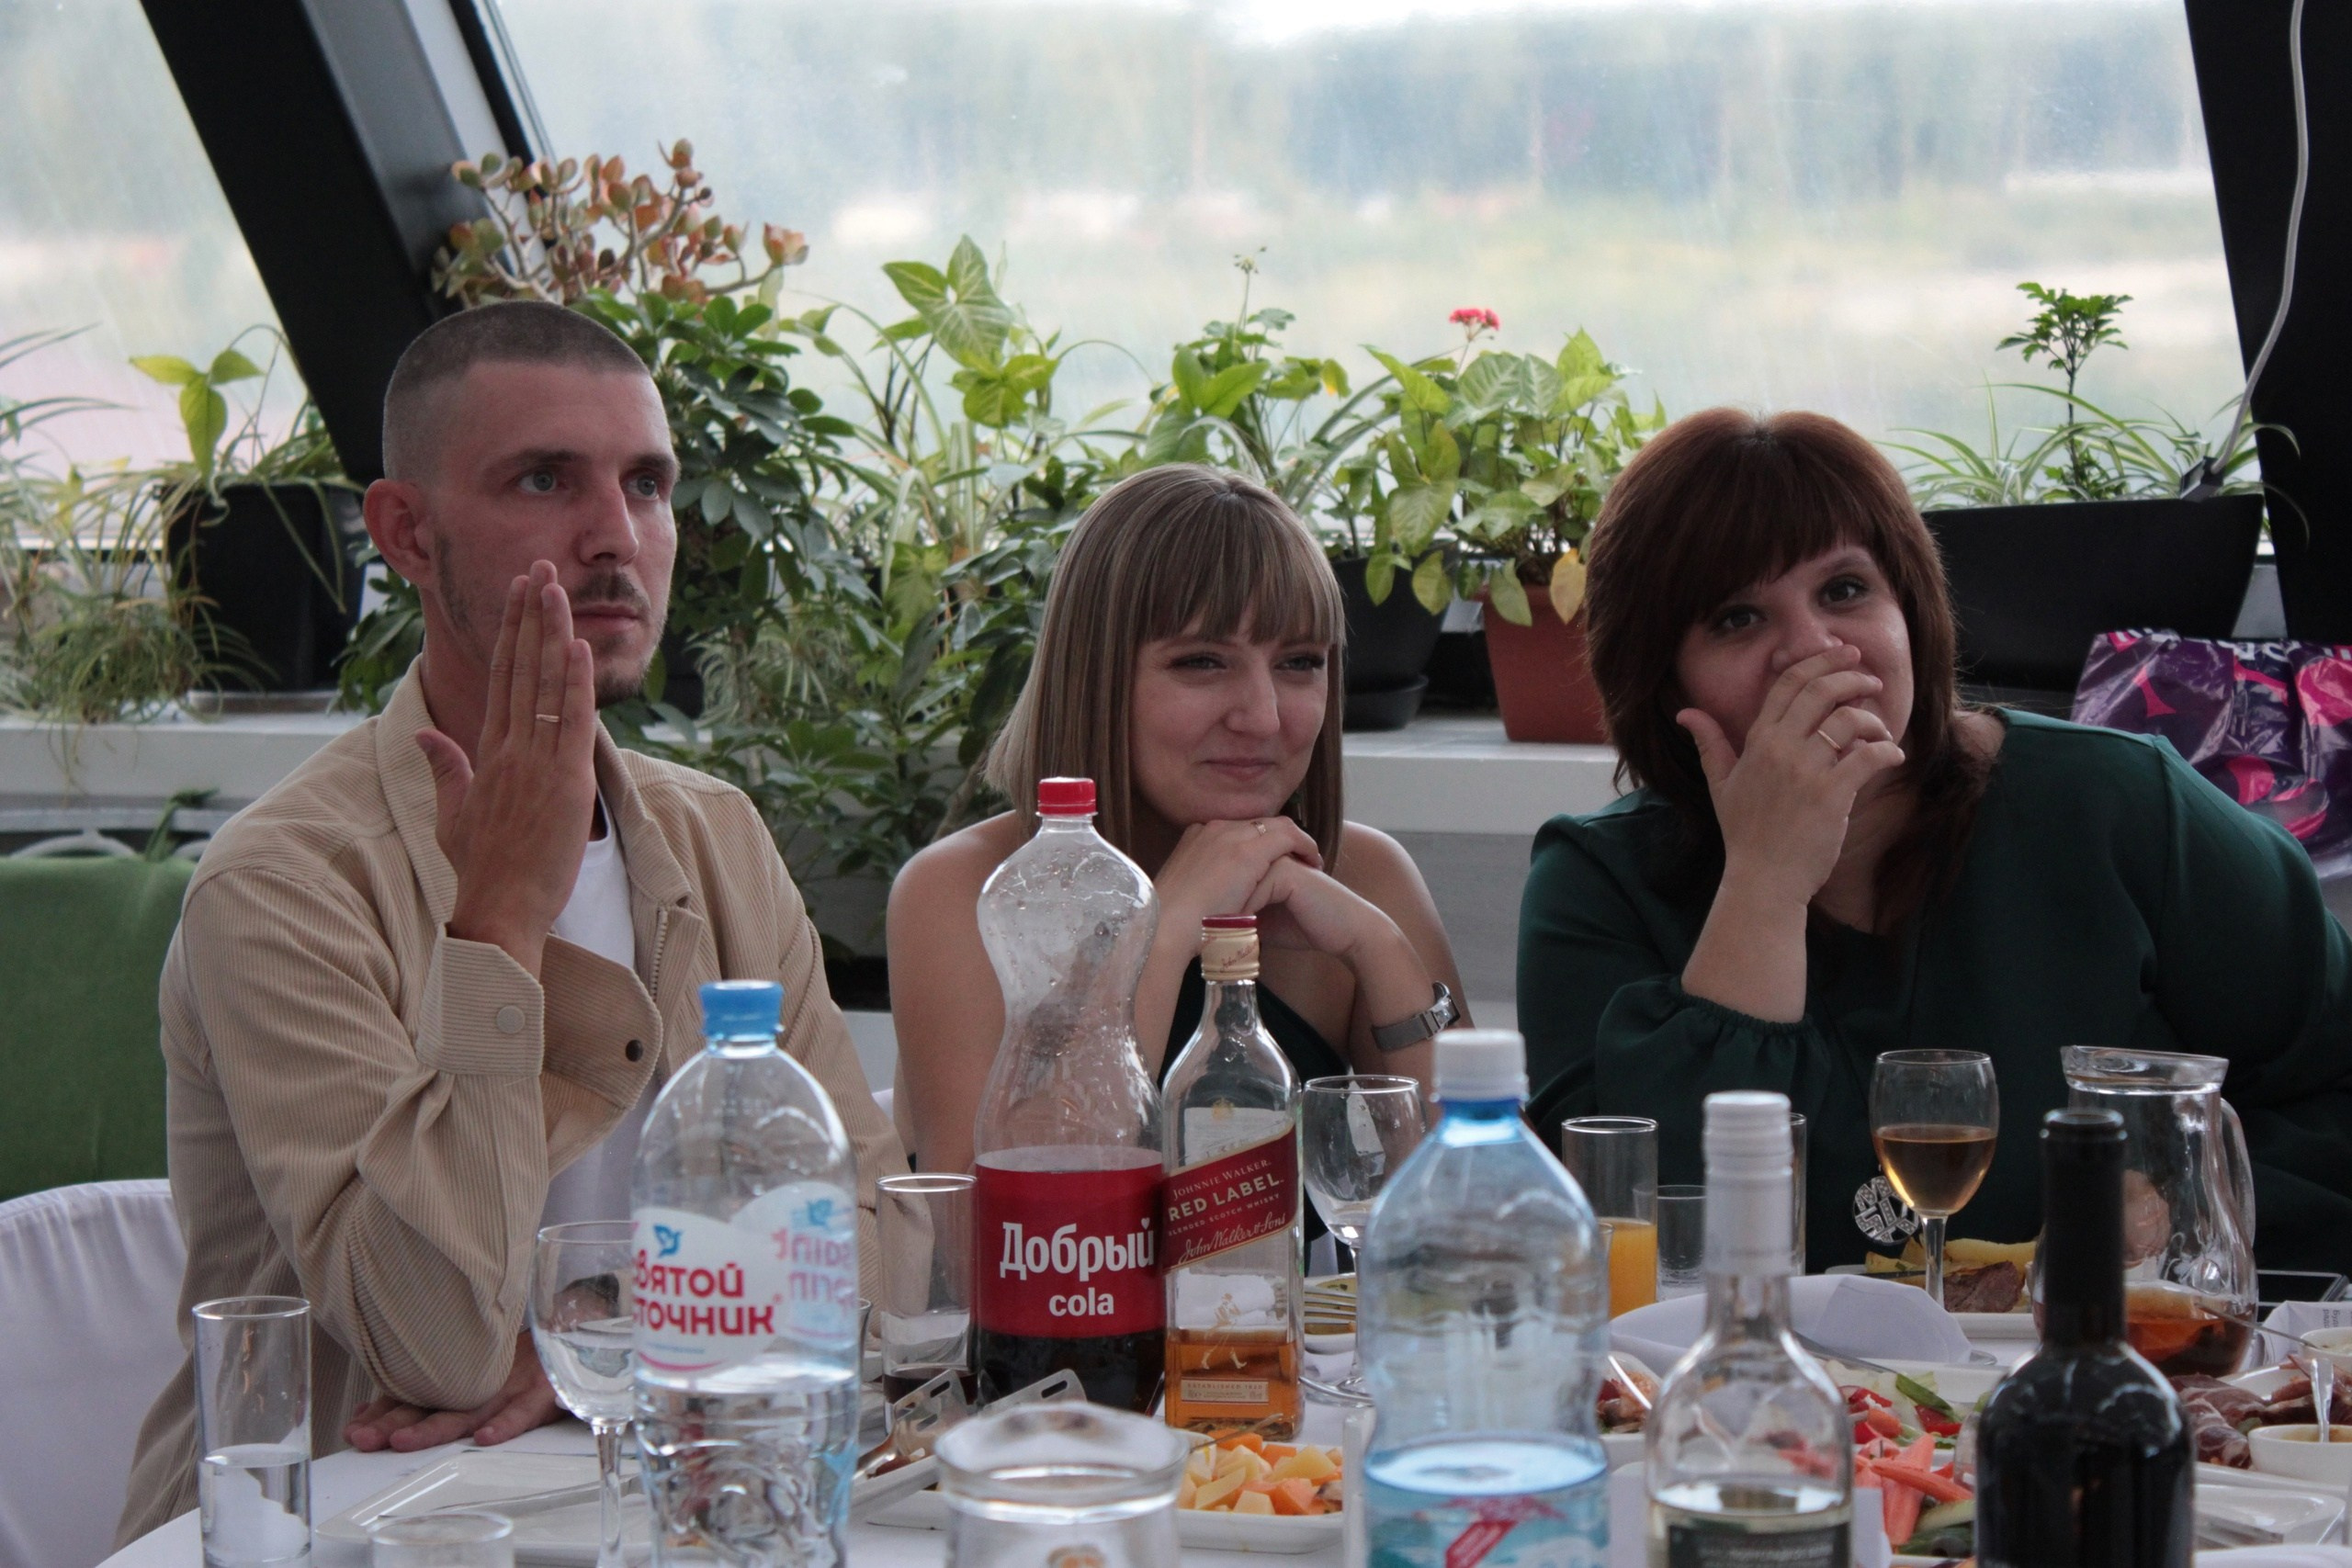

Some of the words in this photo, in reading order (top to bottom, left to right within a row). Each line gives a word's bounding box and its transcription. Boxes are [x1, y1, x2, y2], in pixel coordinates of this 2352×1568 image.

[1168, 1198, 1208, 1222] RED
[1213, 1173, 1281, 1206] LABEL
[1172, 1176, 1221, 1201] JOHNNIE
[1169, 1219, 1206, 1236] BLENDED
[1209, 1207, 1243, 1223] SCOTCH
[1246, 1193, 1280, 1209] WHISKY
[1000, 1217, 1155, 1281] Добрый
[1049, 1287, 1114, 1316] cola
